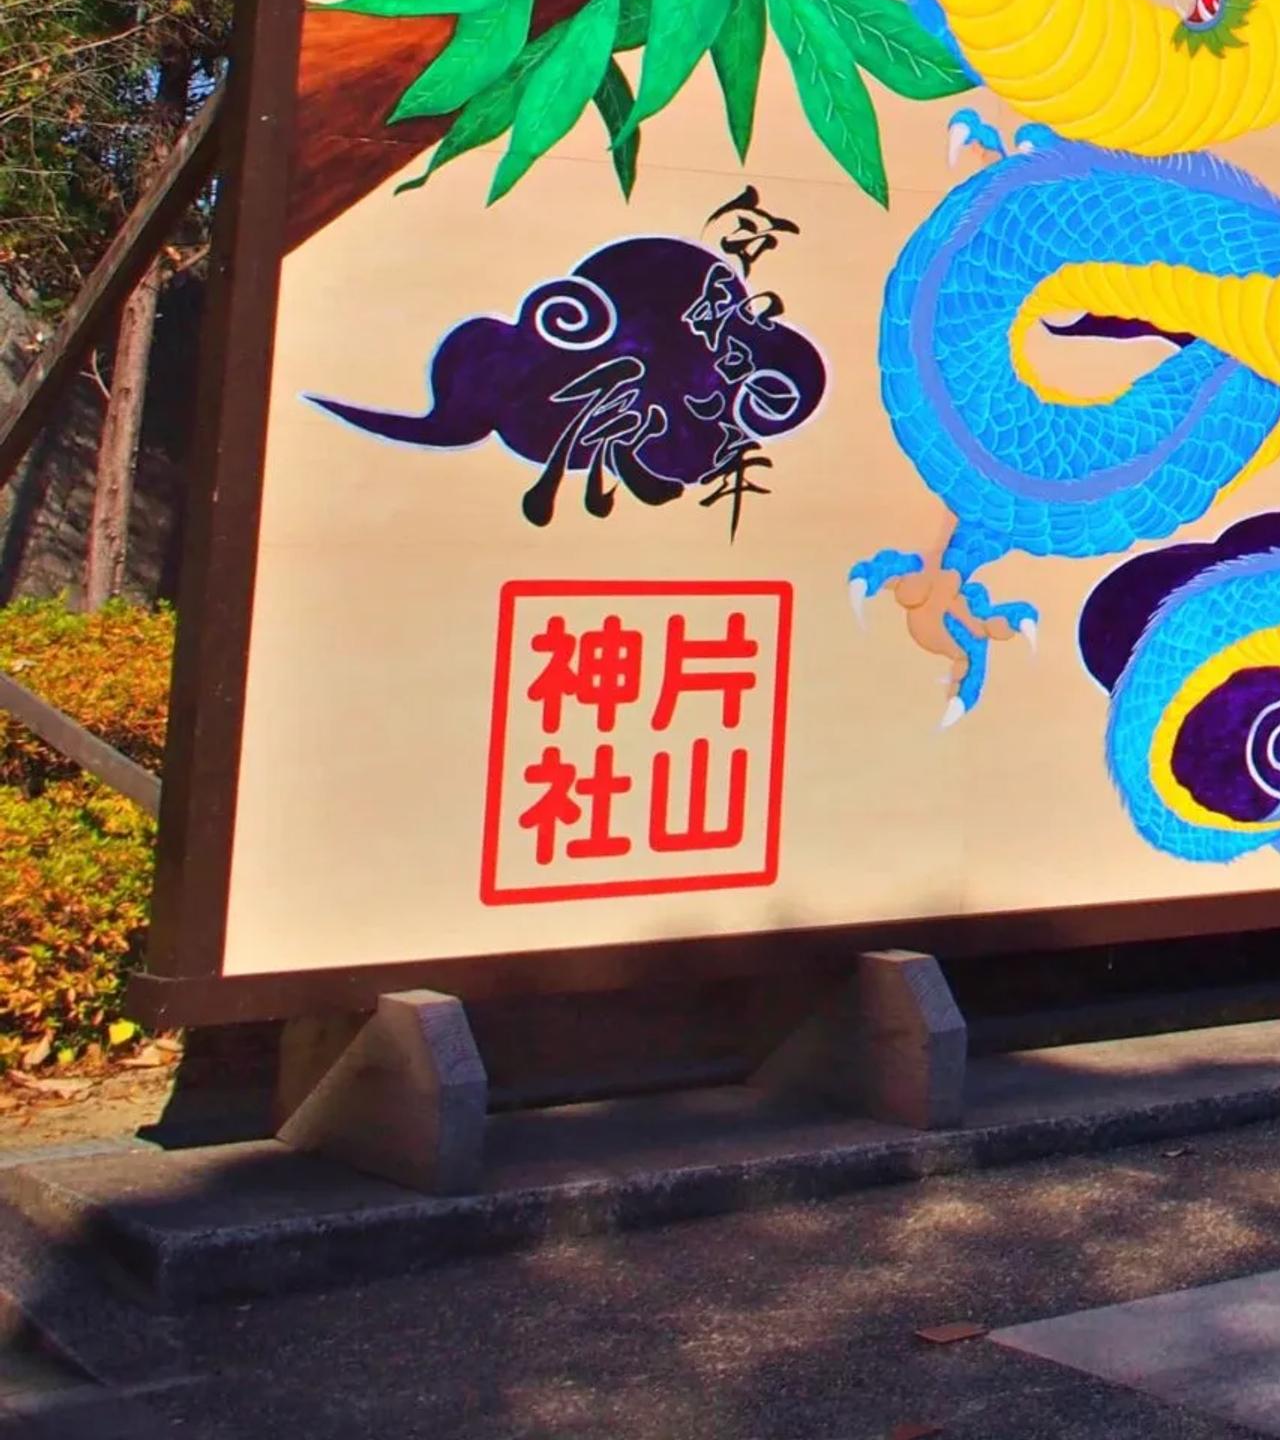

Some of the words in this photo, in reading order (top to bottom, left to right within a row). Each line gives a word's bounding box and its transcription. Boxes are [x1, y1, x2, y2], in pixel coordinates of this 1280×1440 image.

[522, 356, 685, 527] 辰
[517, 613, 642, 867] 神社
[649, 610, 759, 853] 片山
